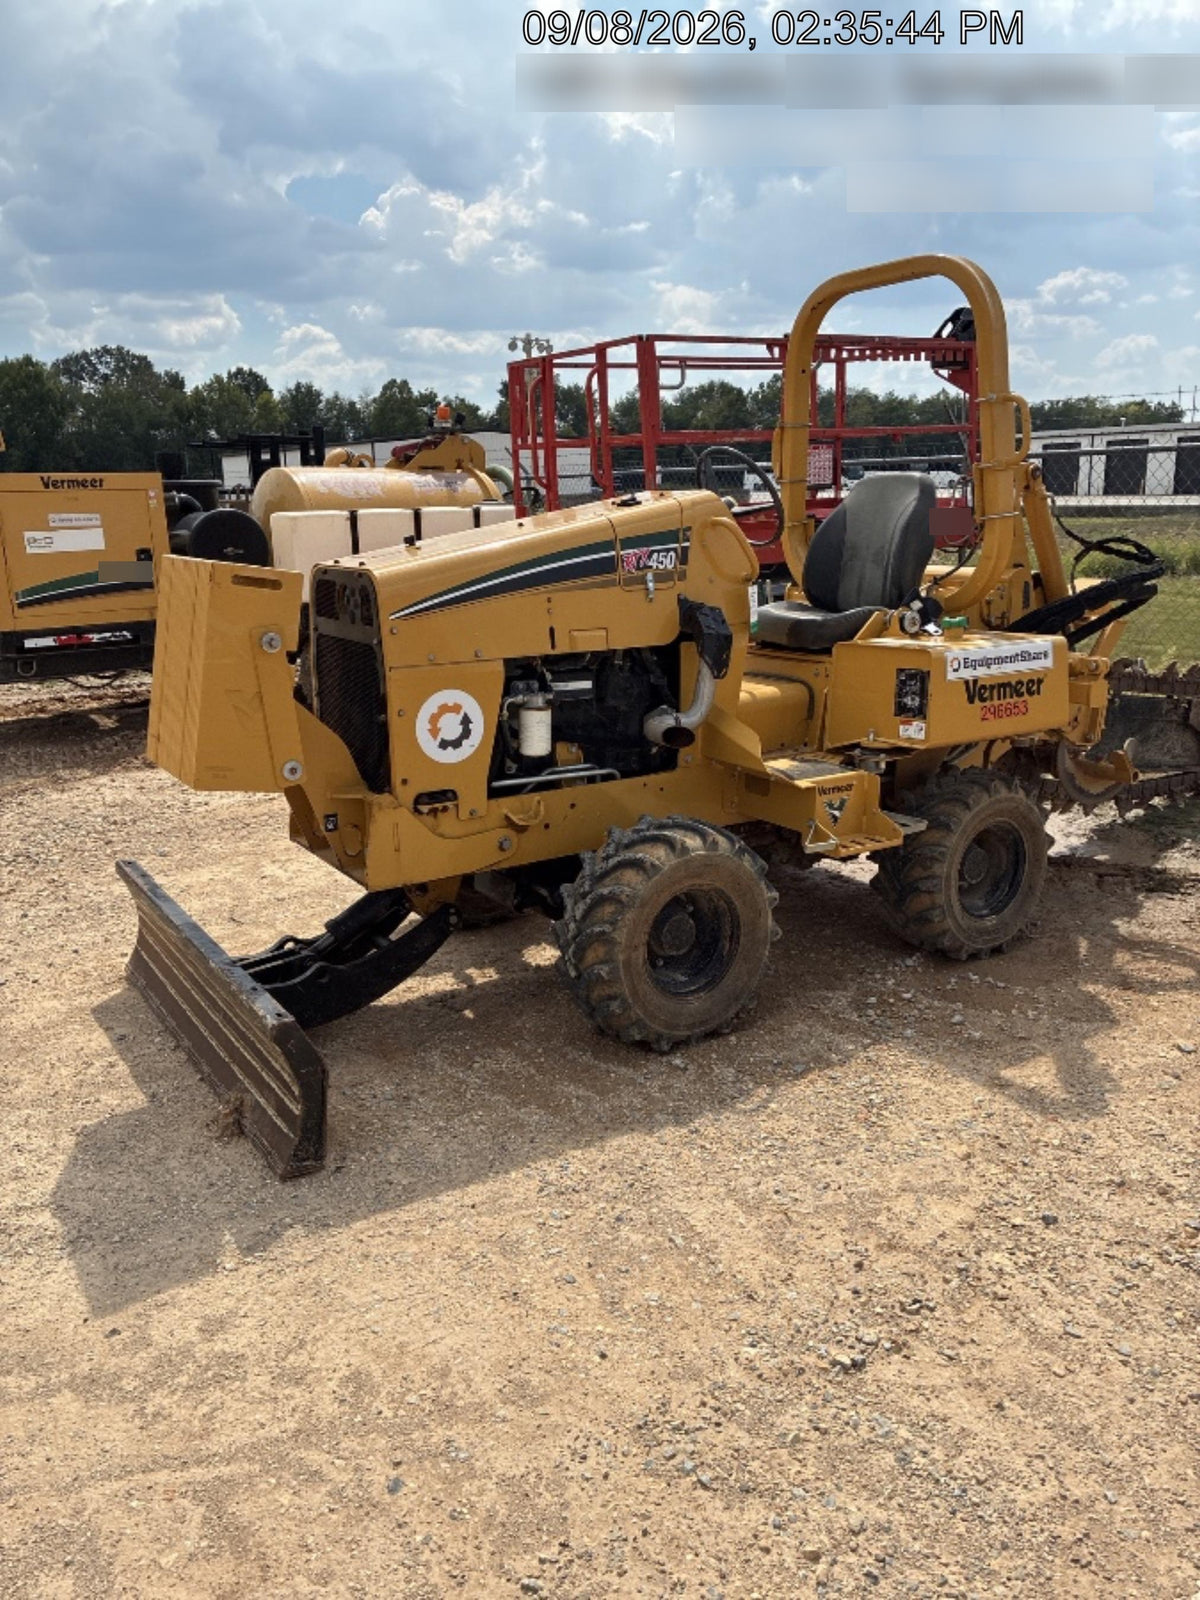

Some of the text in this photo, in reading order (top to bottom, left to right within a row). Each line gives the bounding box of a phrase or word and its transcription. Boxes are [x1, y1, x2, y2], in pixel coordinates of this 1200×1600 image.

[40, 476, 104, 489] Vermeer
[963, 650, 1049, 670] EquipmentShare
[963, 676, 1045, 704] Vermeer
